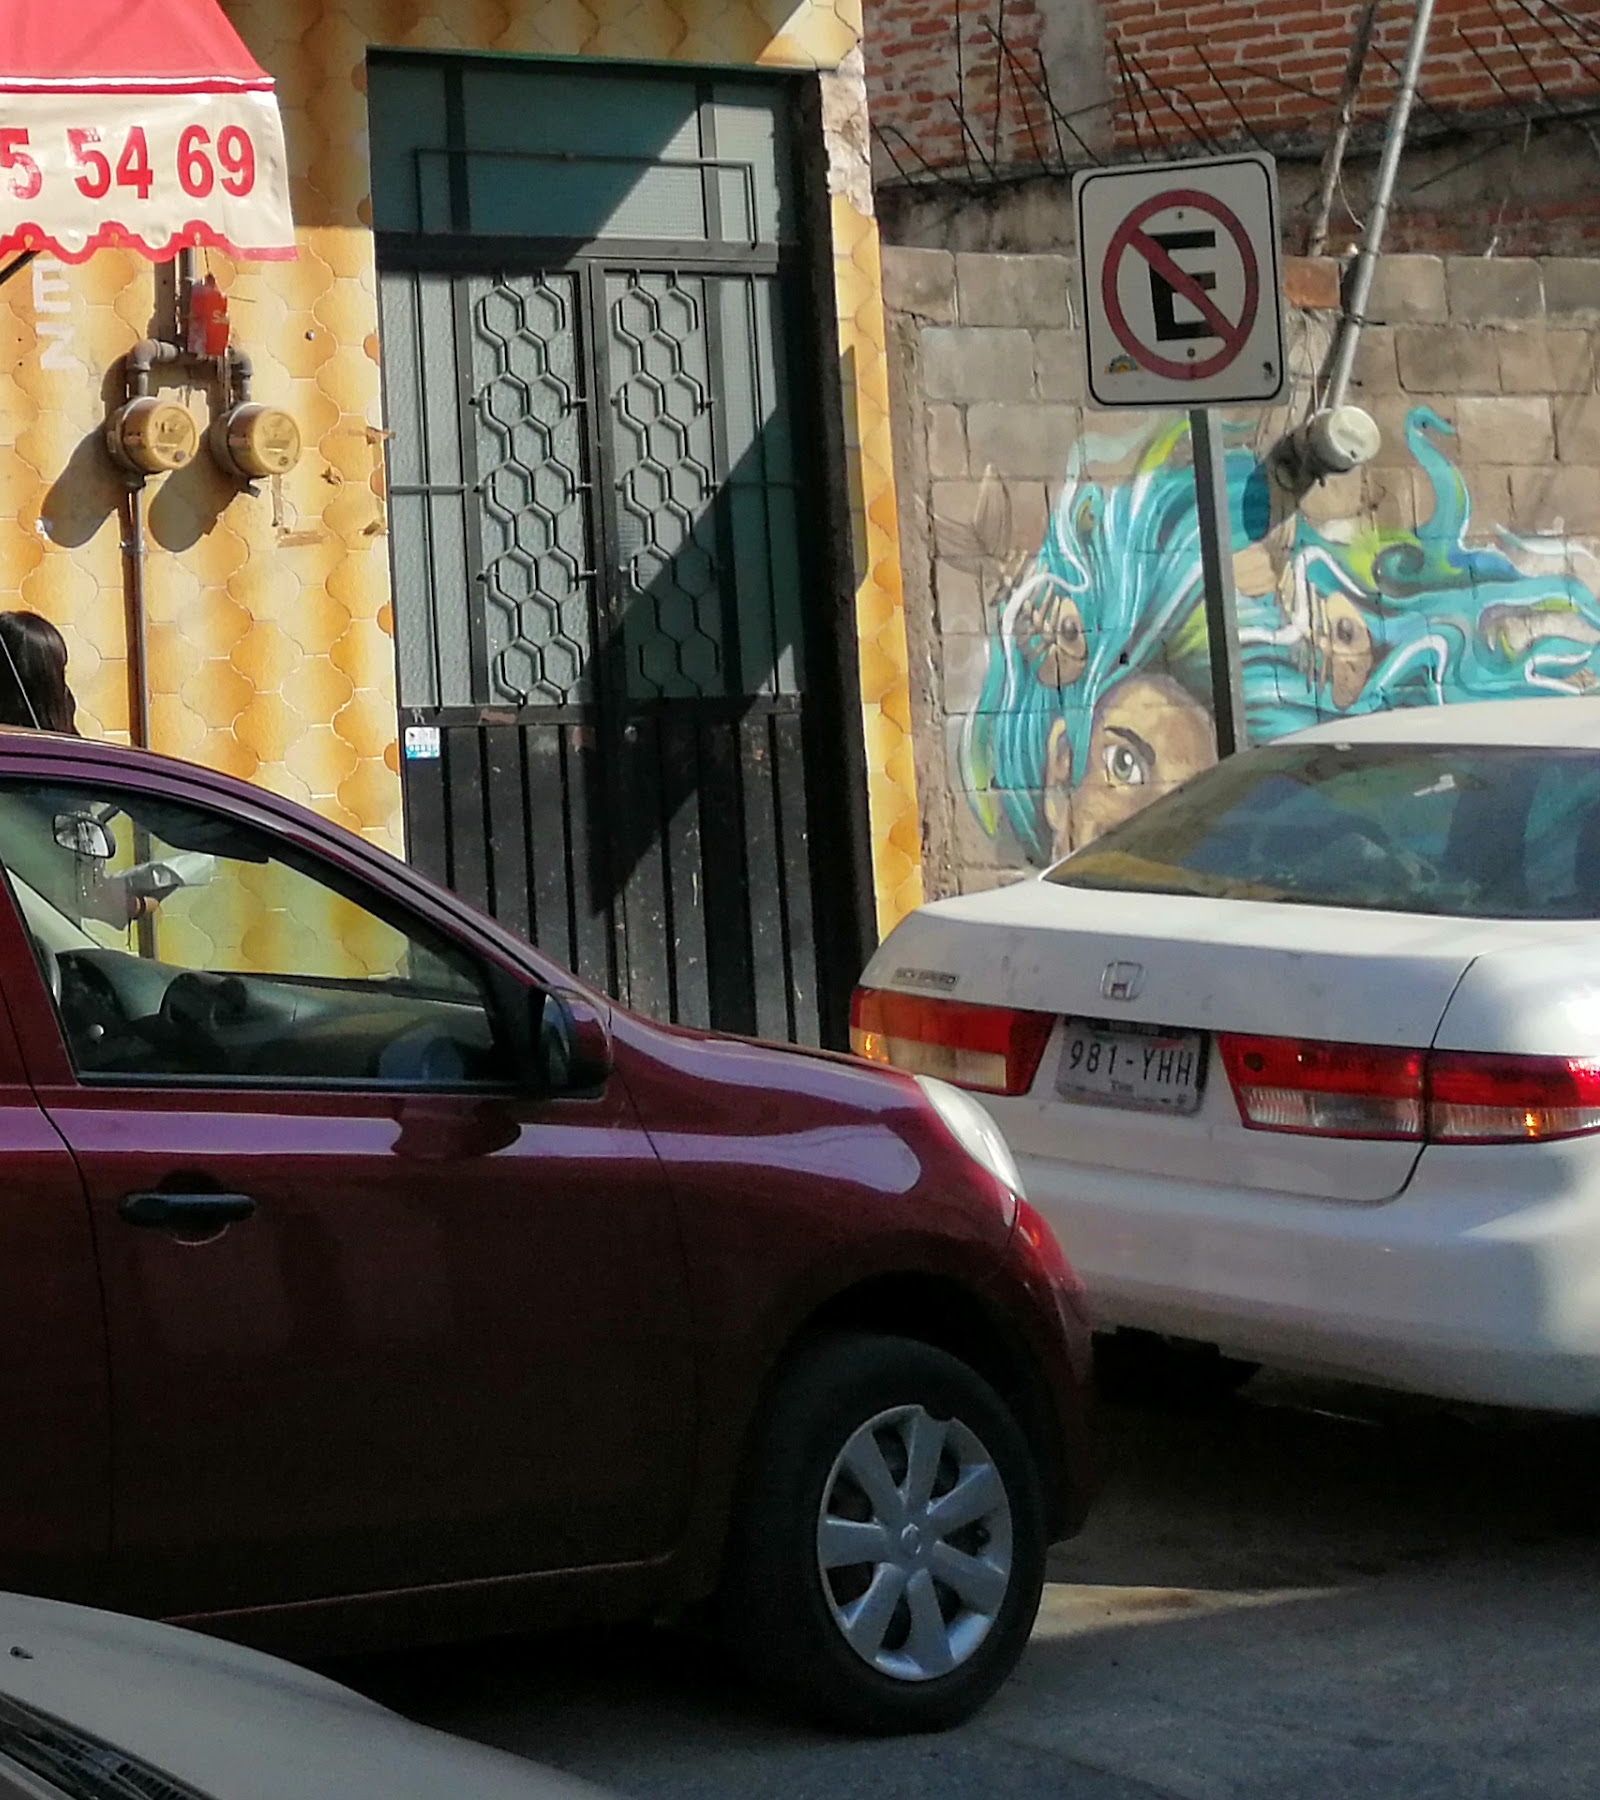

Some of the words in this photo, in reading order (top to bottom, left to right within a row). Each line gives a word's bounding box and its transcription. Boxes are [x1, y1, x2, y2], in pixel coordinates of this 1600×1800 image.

[66, 125, 153, 200] 54
[176, 124, 257, 198] 69
[1147, 229, 1216, 341] E
[1068, 1039, 1194, 1087] 981-YHH
